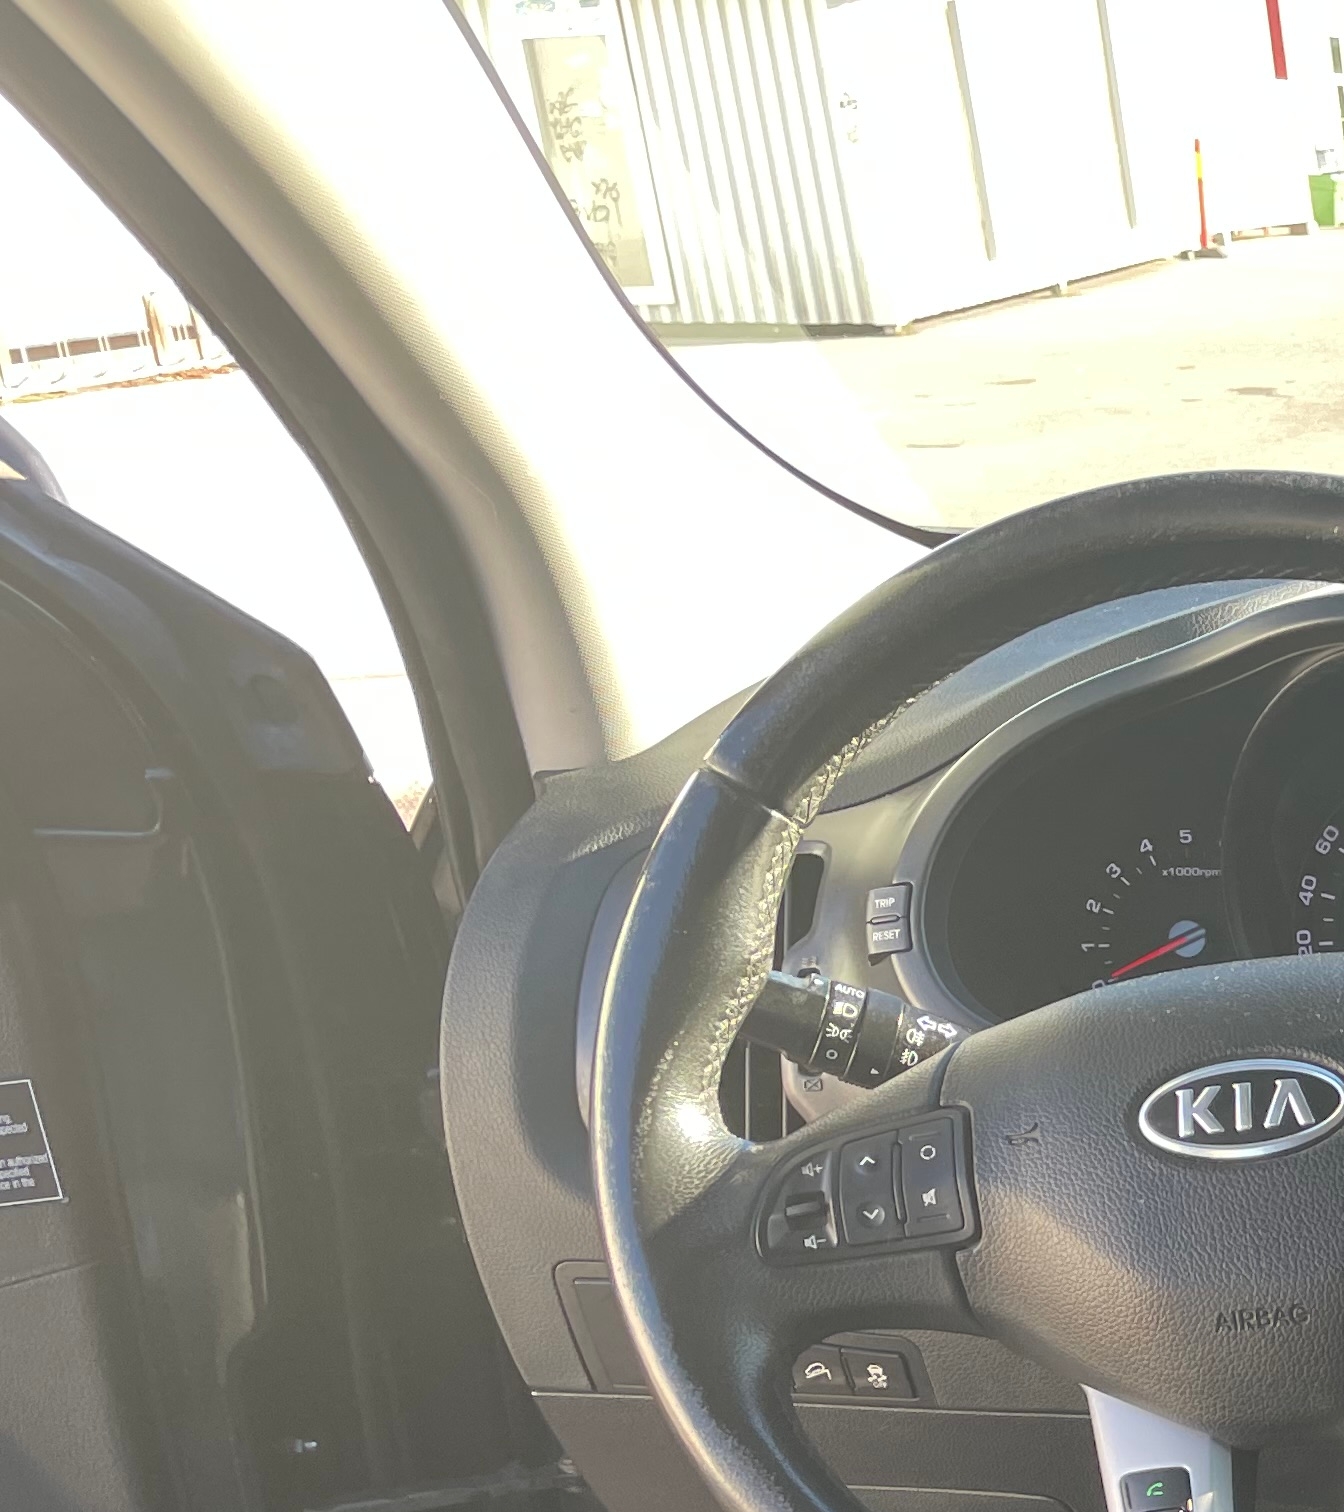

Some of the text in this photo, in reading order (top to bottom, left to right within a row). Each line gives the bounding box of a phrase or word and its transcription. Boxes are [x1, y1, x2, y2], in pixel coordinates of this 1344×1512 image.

[1179, 829, 1193, 844] 5
[1315, 825, 1339, 855] 60
[1140, 838, 1153, 853] 4
[1106, 863, 1121, 879] 3
[1162, 867, 1222, 879] x1000rpm
[1299, 875, 1317, 906] 40
[874, 897, 896, 909] TRIP
[1086, 899, 1101, 914] 2
[872, 929, 901, 941] RESET
[1081, 943, 1095, 952] 1
[834, 983, 865, 999] AUTO
[1175, 1078, 1316, 1138] KIA
[1214, 1302, 1311, 1333] AIRBAG
